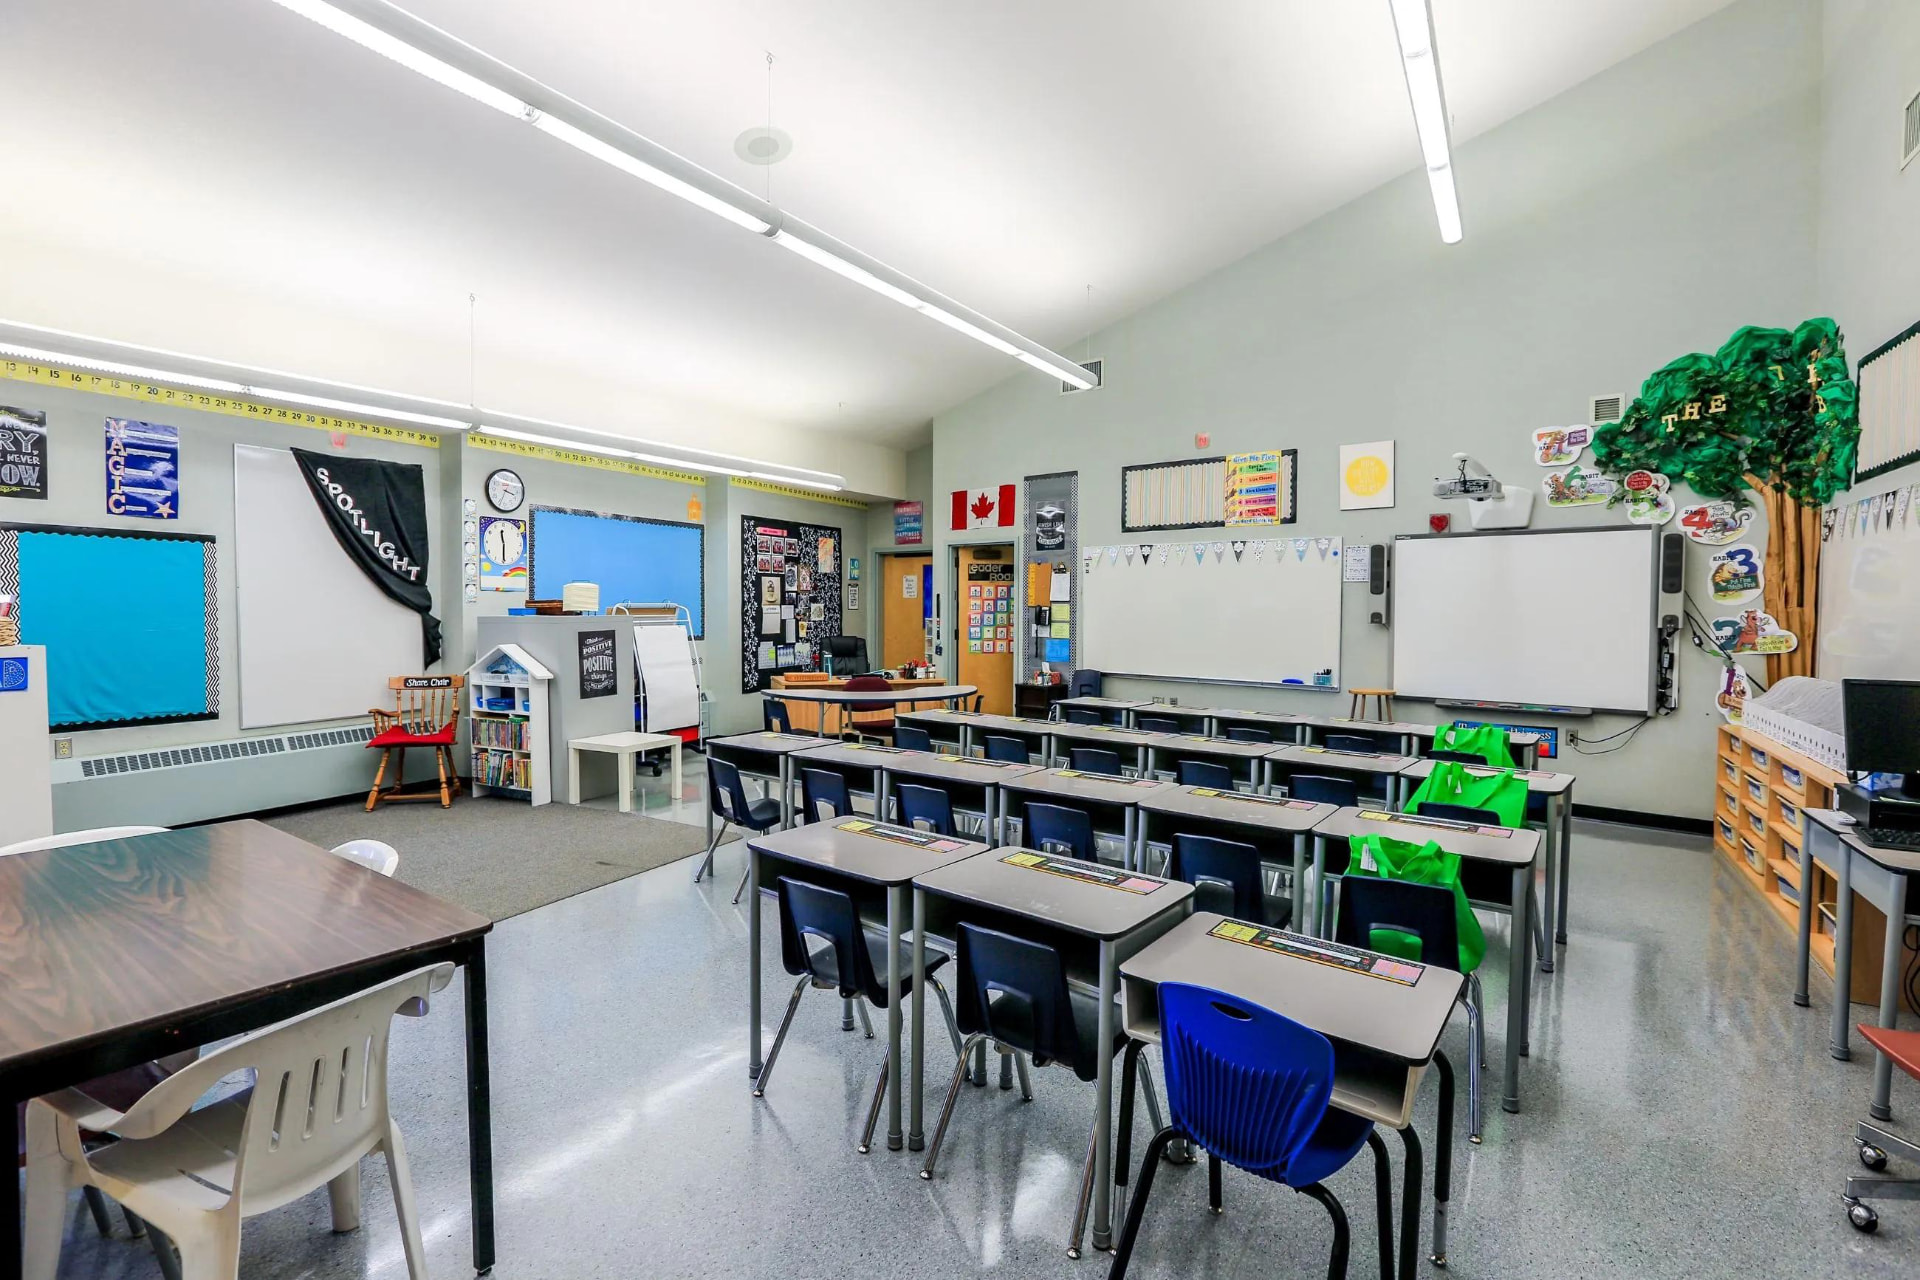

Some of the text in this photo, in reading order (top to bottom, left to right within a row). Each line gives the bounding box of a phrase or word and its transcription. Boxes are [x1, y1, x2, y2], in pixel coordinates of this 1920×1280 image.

[6, 362, 16, 371] 13
[28, 366, 38, 375] 14
[49, 370, 60, 378] 15
[72, 374, 82, 382] 16
[92, 376, 101, 385] 17
[111, 380, 120, 388] 18
[130, 384, 140, 392] 19
[147, 386, 158, 395] 20
[182, 393, 193, 402] 22
[200, 396, 210, 404] 23
[232, 402, 242, 410] 25
[292, 412, 301, 420] 29
[1661, 394, 1726, 432] THE
[7, 454, 40, 464] NEVER
[316, 468, 420, 580] SPOTLIGHT
[969, 564, 1004, 574] Leader
[1726, 548, 1758, 574] 3
[583, 640, 612, 654] POSITIVE
[584, 656, 614, 676] POSITIVE
[406, 678, 450, 686] Share Chair
